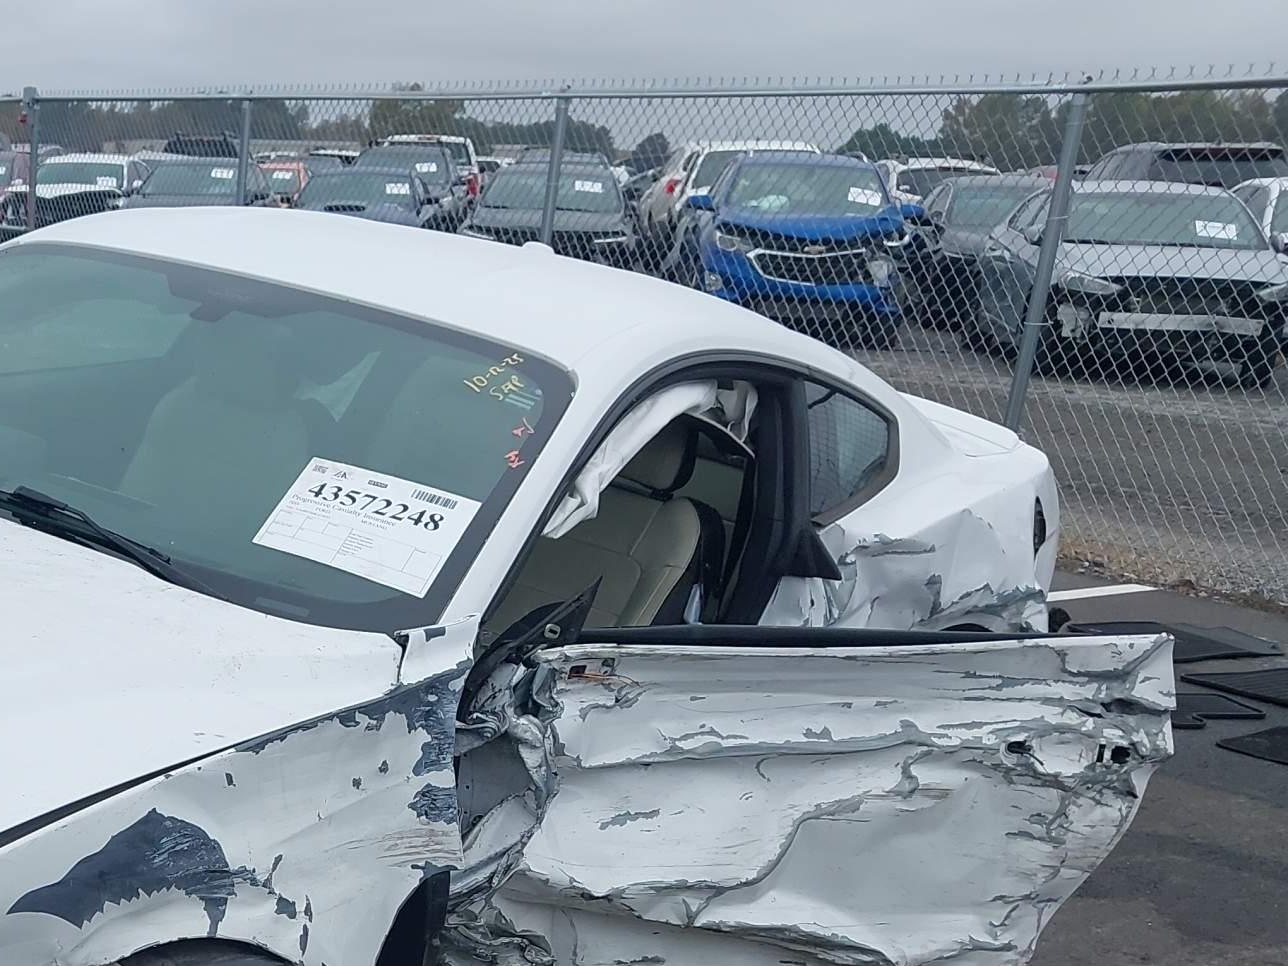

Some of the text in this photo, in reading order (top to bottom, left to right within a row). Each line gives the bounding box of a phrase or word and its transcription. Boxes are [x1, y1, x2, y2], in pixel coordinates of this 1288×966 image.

[291, 494, 331, 509] Progressive
[332, 504, 362, 518] Casualty
[363, 512, 397, 527] Insurance
[308, 482, 445, 532] 43572248
